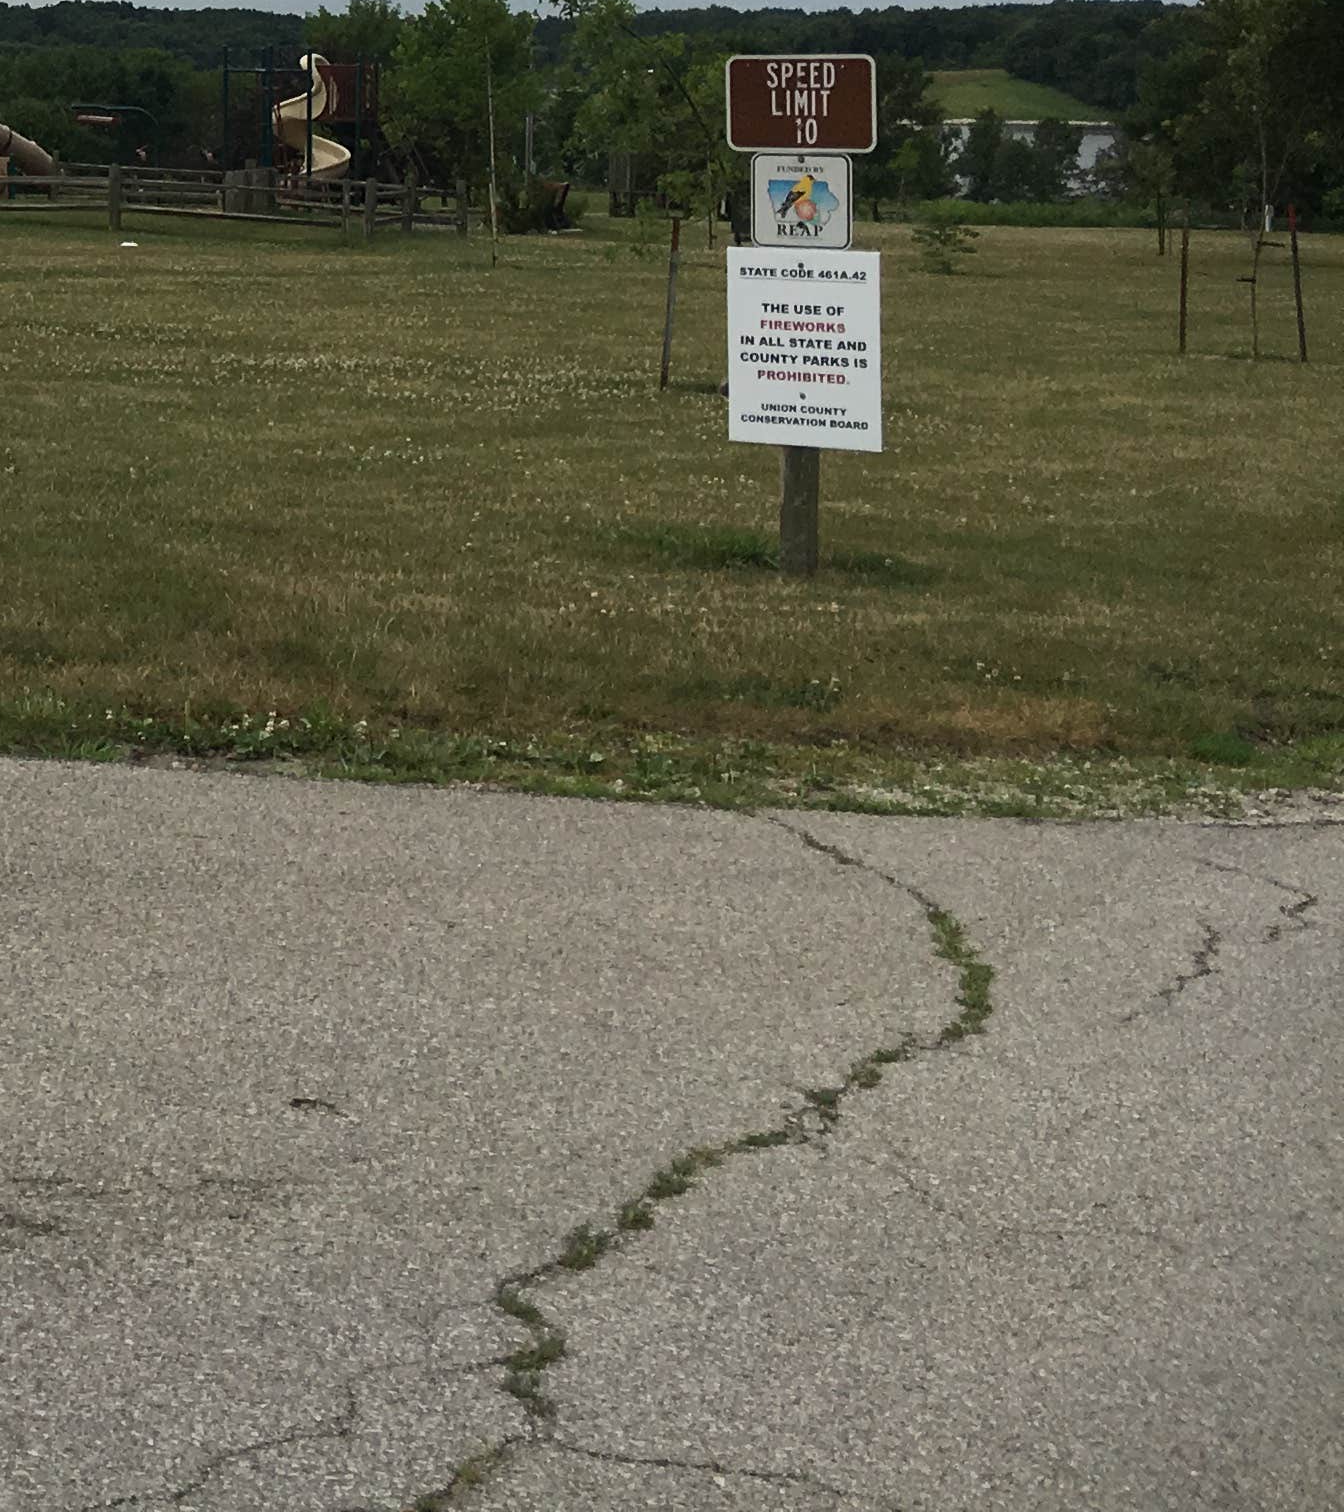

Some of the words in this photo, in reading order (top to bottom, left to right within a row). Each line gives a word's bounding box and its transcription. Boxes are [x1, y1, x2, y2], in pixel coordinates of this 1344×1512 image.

[766, 62, 835, 88] SPEED
[771, 90, 830, 116] LIMIT
[795, 119, 817, 144] 10
[777, 223, 823, 237] REAP
[740, 267, 777, 277] STATE
[781, 268, 814, 278] CODE
[818, 270, 867, 280] 461A.42
[762, 303, 789, 314] THE
[794, 305, 821, 315] USE
[826, 306, 844, 316] OF
[760, 320, 846, 333] FIREWORKS
[740, 336, 754, 345] IN
[759, 337, 784, 347] ALL
[789, 339, 832, 350] STATE
[837, 341, 867, 351] AND
[740, 352, 798, 364] COUNTY
[803, 356, 849, 367] PARKS
[854, 358, 868, 368] IS
[758, 370, 850, 385] PROHIBITED.
[761, 403, 797, 412] UNION
[800, 406, 847, 416] COUNTY
[741, 414, 826, 427] CONSERVATION
[830, 421, 868, 430] BOARD
